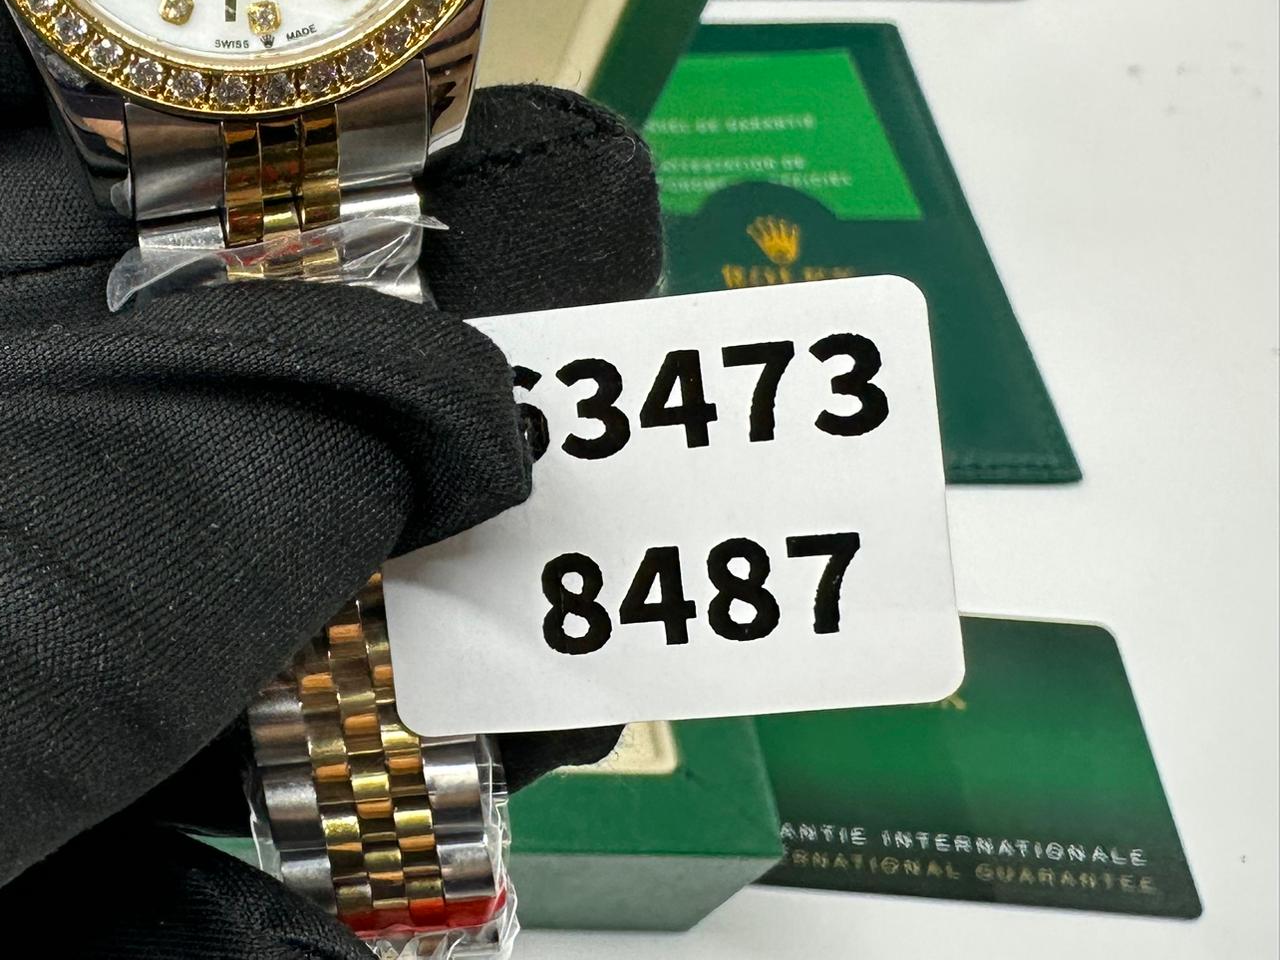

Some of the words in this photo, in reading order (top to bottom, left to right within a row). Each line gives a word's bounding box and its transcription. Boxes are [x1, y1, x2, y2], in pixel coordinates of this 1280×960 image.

[214, 39, 250, 49] SWISS
[286, 23, 318, 41] MADE
[541, 532, 861, 656] 8487
[881, 829, 1148, 867] INTERNATIONALE
[975, 862, 1157, 893] GUARANTEE
